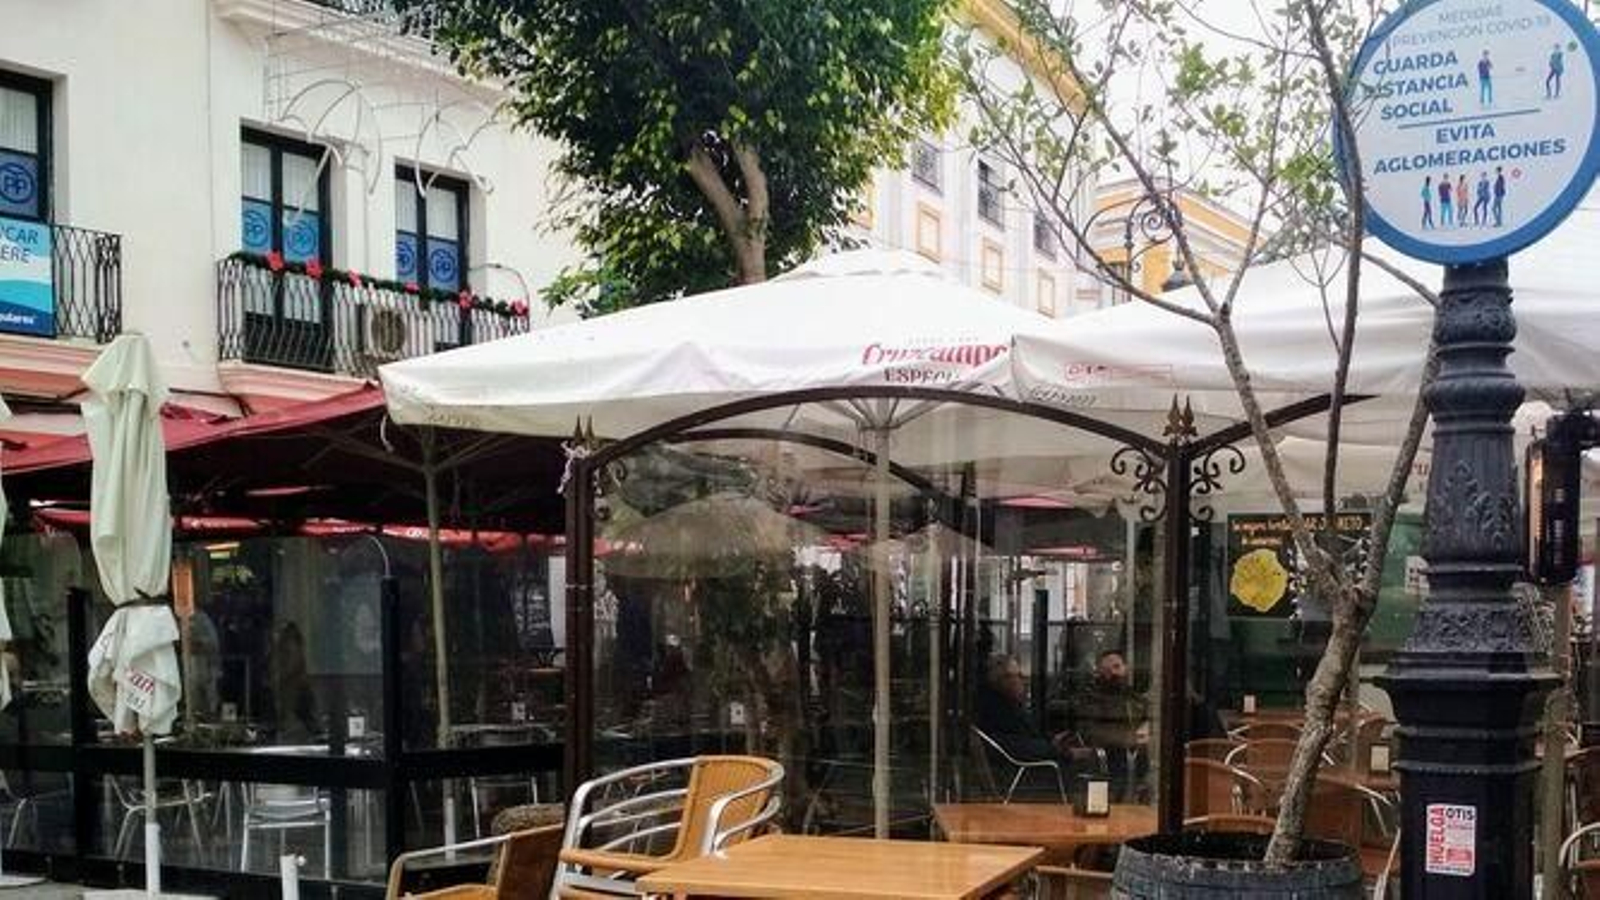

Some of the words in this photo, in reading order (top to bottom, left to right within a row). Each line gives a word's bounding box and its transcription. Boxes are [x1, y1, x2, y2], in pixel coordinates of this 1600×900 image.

[1438, 4, 1503, 23] MEDIDAS
[1373, 51, 1458, 75] GUARDA
[1380, 99, 1453, 120] SOCIAL
[1435, 123, 1496, 144] EVITA
[1373, 138, 1567, 175] AGLOMERACIONES
[0, 224, 38, 245] CAR
[0, 244, 29, 264] ERE
[1446, 807, 1474, 821] OTIS
